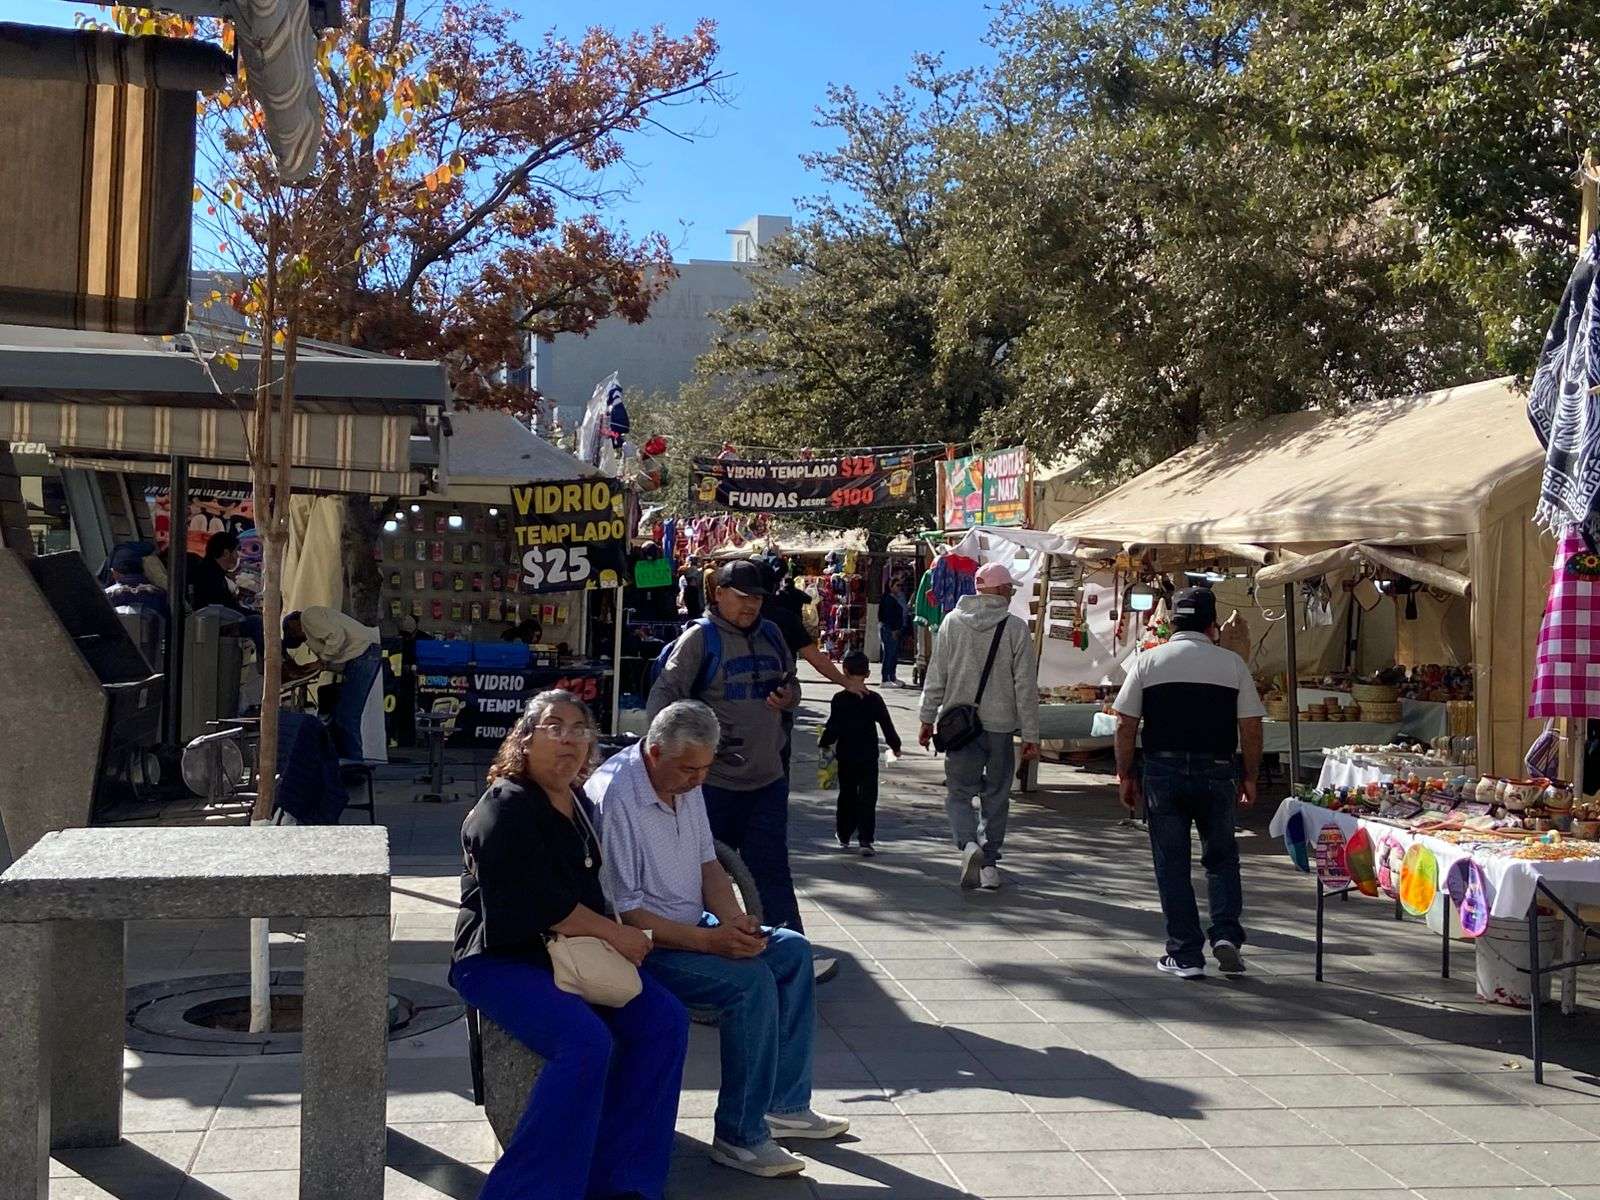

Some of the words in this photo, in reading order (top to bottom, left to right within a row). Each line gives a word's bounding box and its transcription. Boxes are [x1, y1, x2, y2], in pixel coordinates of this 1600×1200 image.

[726, 465, 767, 479] VIDRIO
[770, 463, 838, 479] TEMPLADO
[840, 455, 876, 478] $25
[512, 481, 610, 515] VIDRIO
[728, 491, 798, 508] FUNDAS
[800, 497, 826, 507] DESDE
[831, 487, 875, 509] $100
[514, 520, 625, 546] TEMPLADO
[522, 545, 591, 589] $25
[474, 674, 525, 691] VIDRIO
[478, 698, 525, 713] TEMPL
[475, 726, 508, 738] FUND
